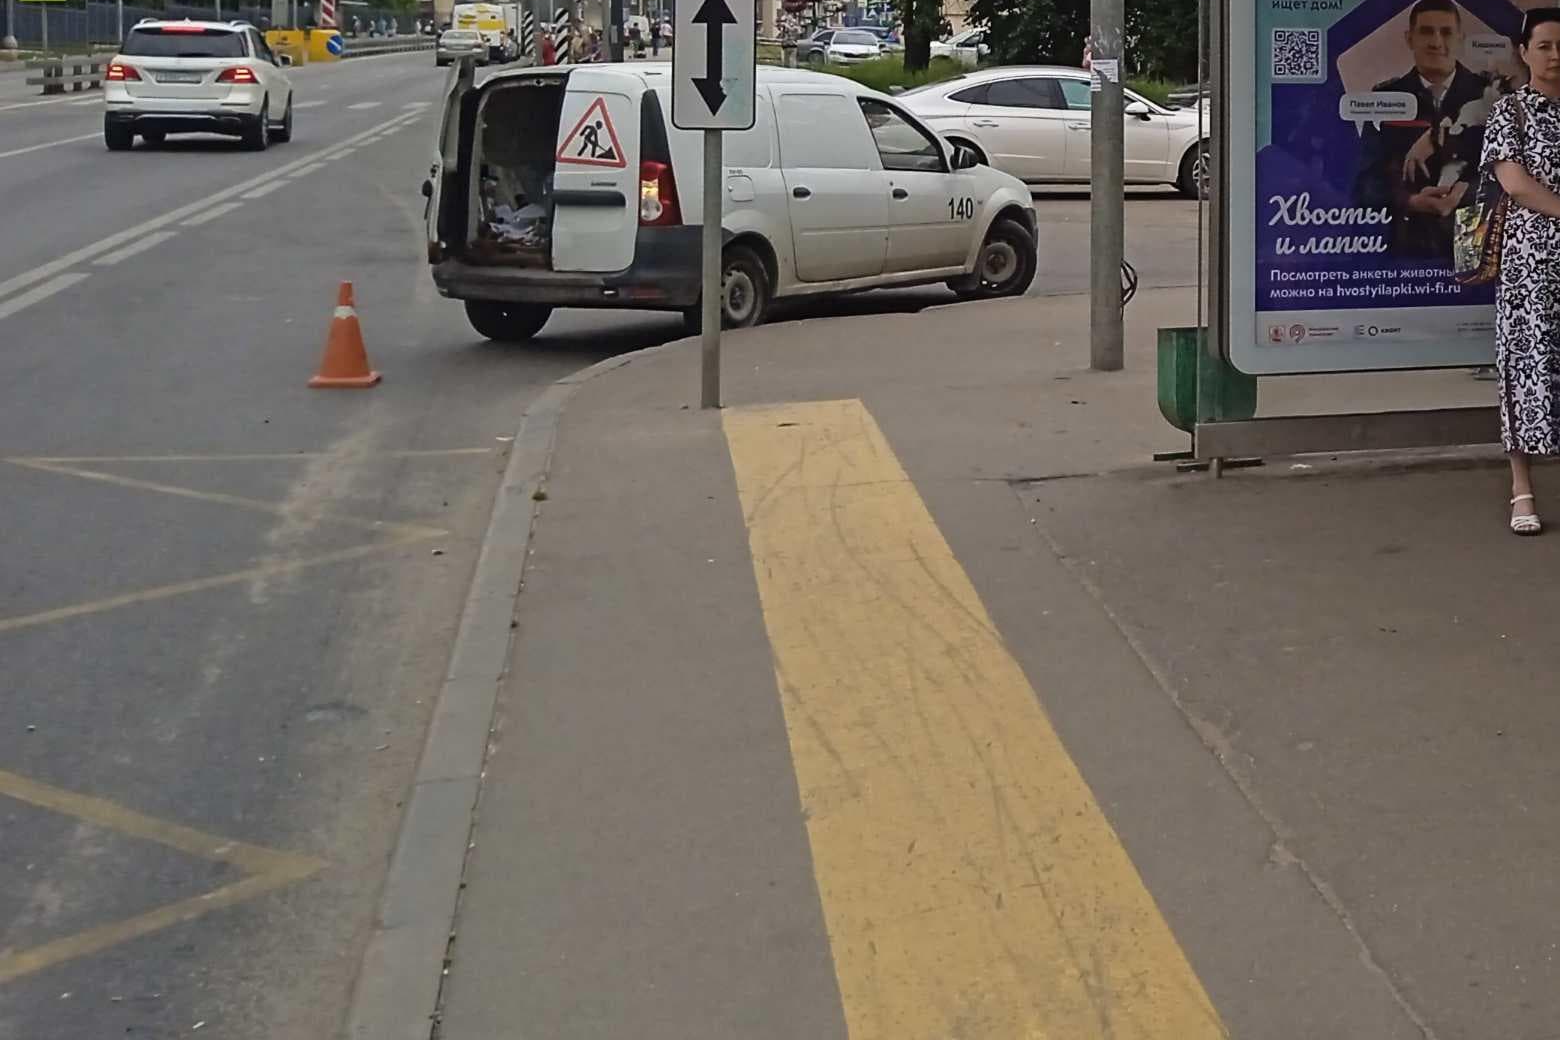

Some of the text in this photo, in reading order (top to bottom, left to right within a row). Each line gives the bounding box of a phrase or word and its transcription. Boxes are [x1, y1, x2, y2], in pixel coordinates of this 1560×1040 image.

[1272, 0, 1307, 11] ищет
[948, 197, 974, 220] 140
[1268, 191, 1393, 226] Хвосты
[1275, 235, 1388, 255] и лапки
[1270, 267, 1456, 282] Посмотреть анкеты животны
[1270, 281, 1461, 298] можно на hvostyilapki.wi-fi.ru
